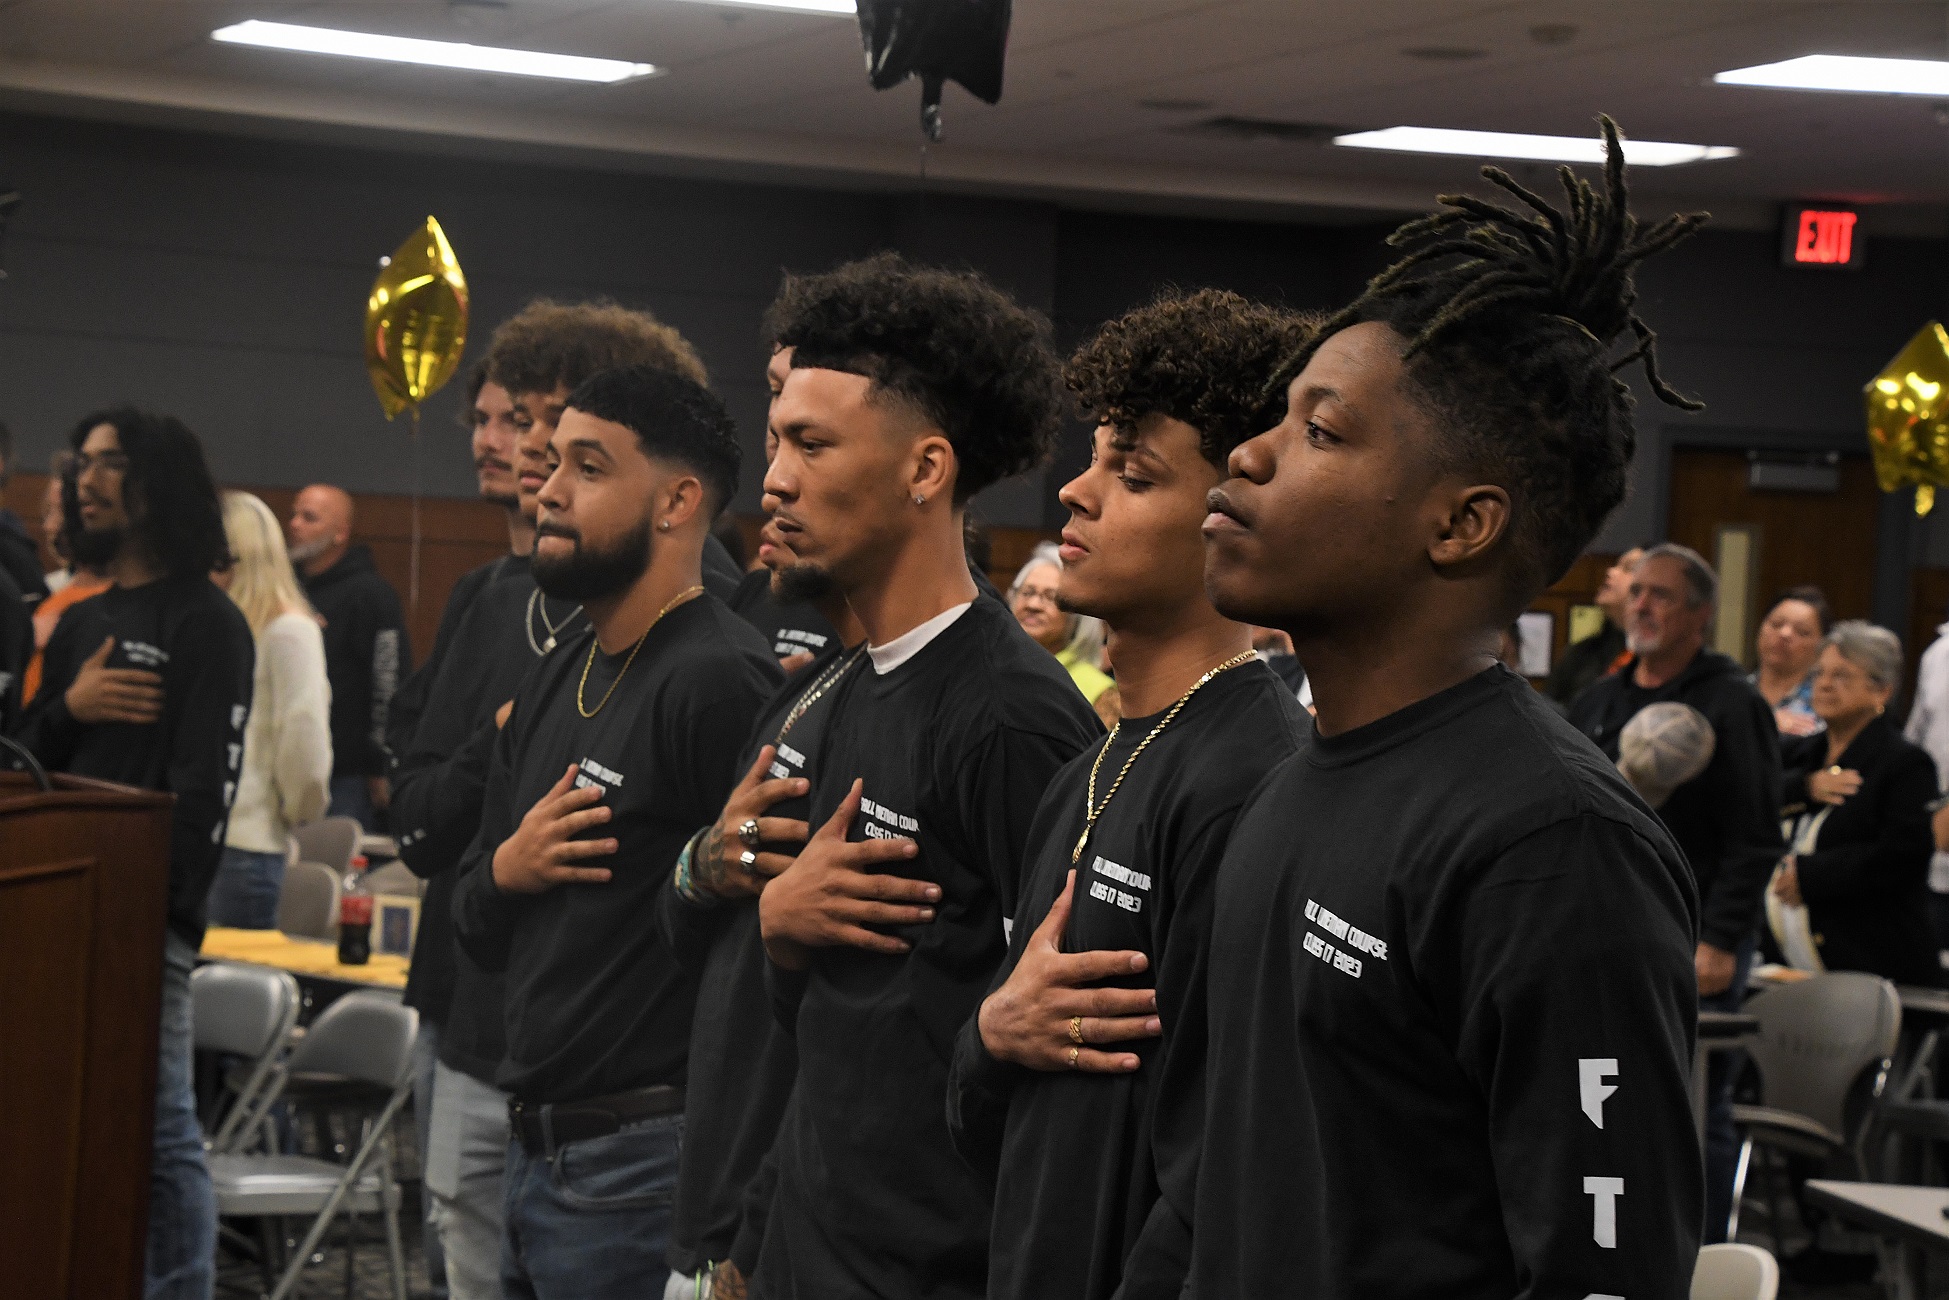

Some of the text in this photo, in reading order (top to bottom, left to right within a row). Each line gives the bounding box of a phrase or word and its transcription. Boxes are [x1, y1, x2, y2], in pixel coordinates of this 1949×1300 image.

[1795, 210, 1858, 264] EXIT
[1578, 1058, 1620, 1130] F
[1583, 1176, 1625, 1249] T
